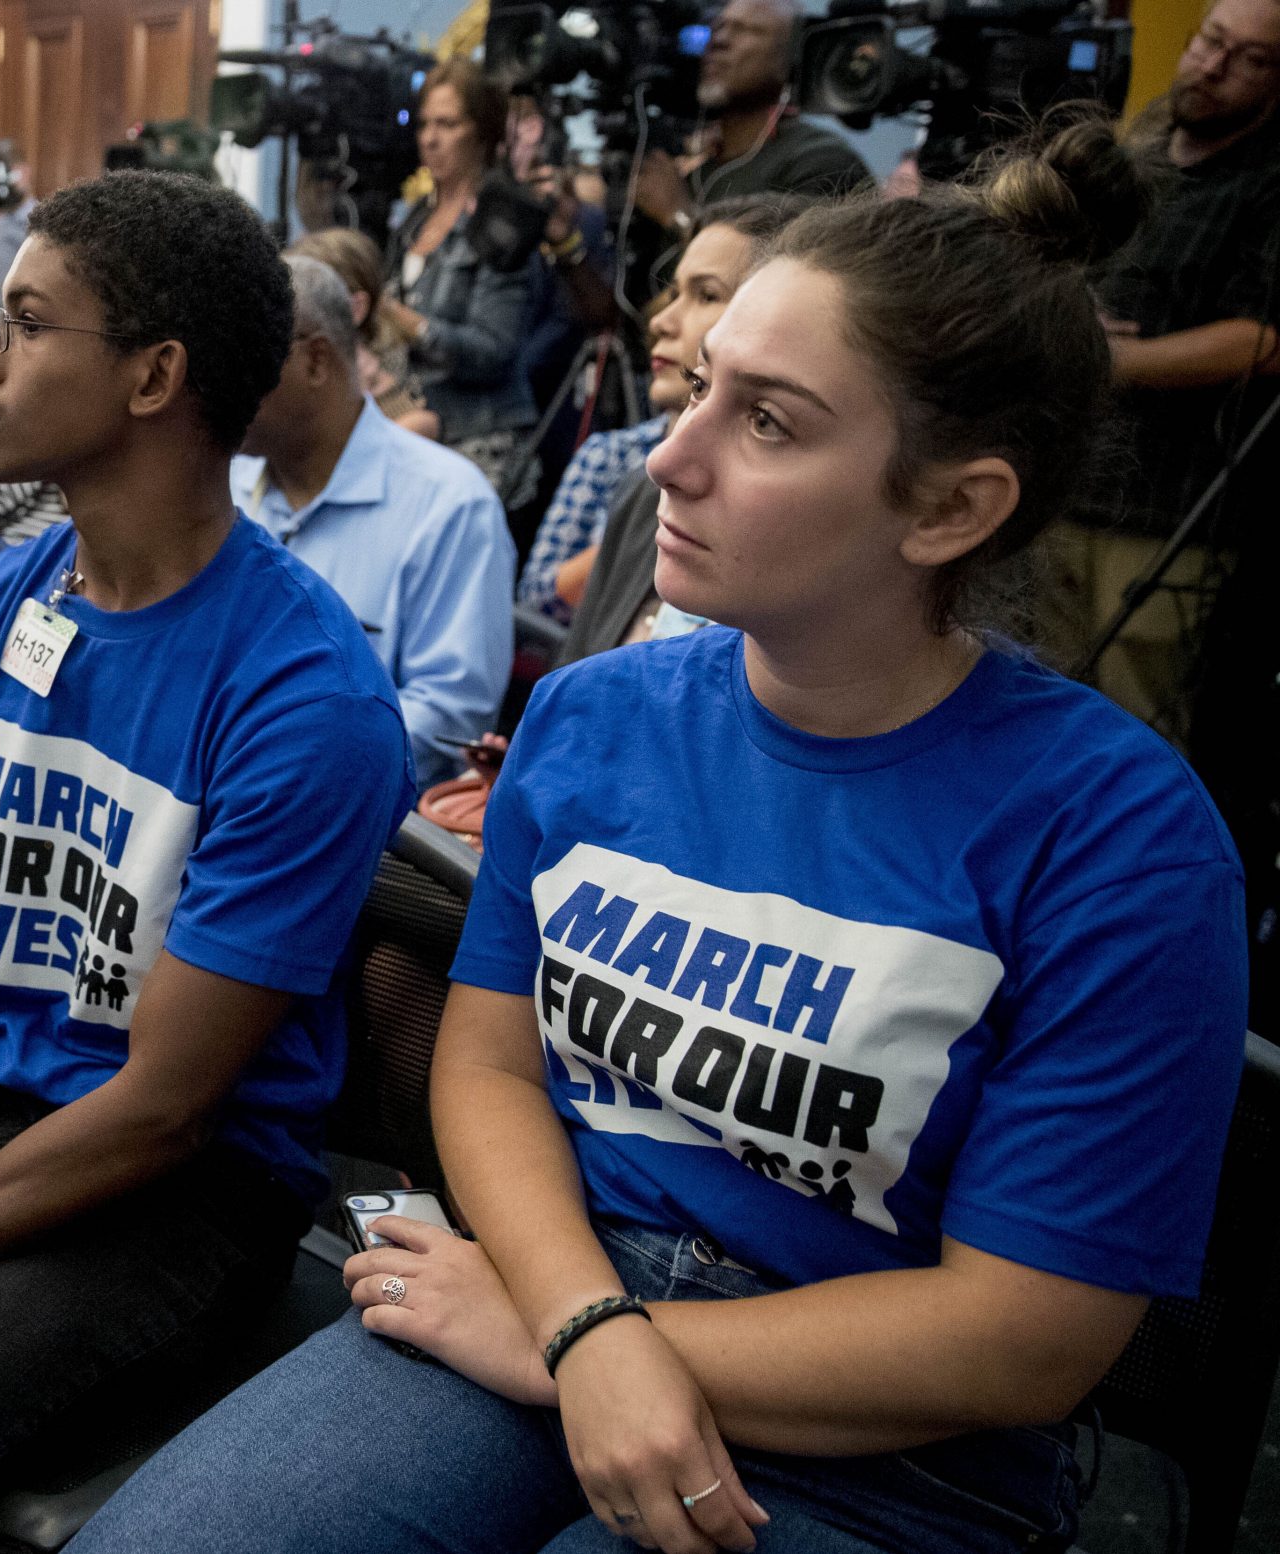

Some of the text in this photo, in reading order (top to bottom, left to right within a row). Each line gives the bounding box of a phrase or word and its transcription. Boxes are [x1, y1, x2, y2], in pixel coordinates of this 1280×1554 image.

[11, 629, 55, 668] H-137
[542, 880, 856, 1046] MARCH
[542, 955, 885, 1154] FOR OUR
